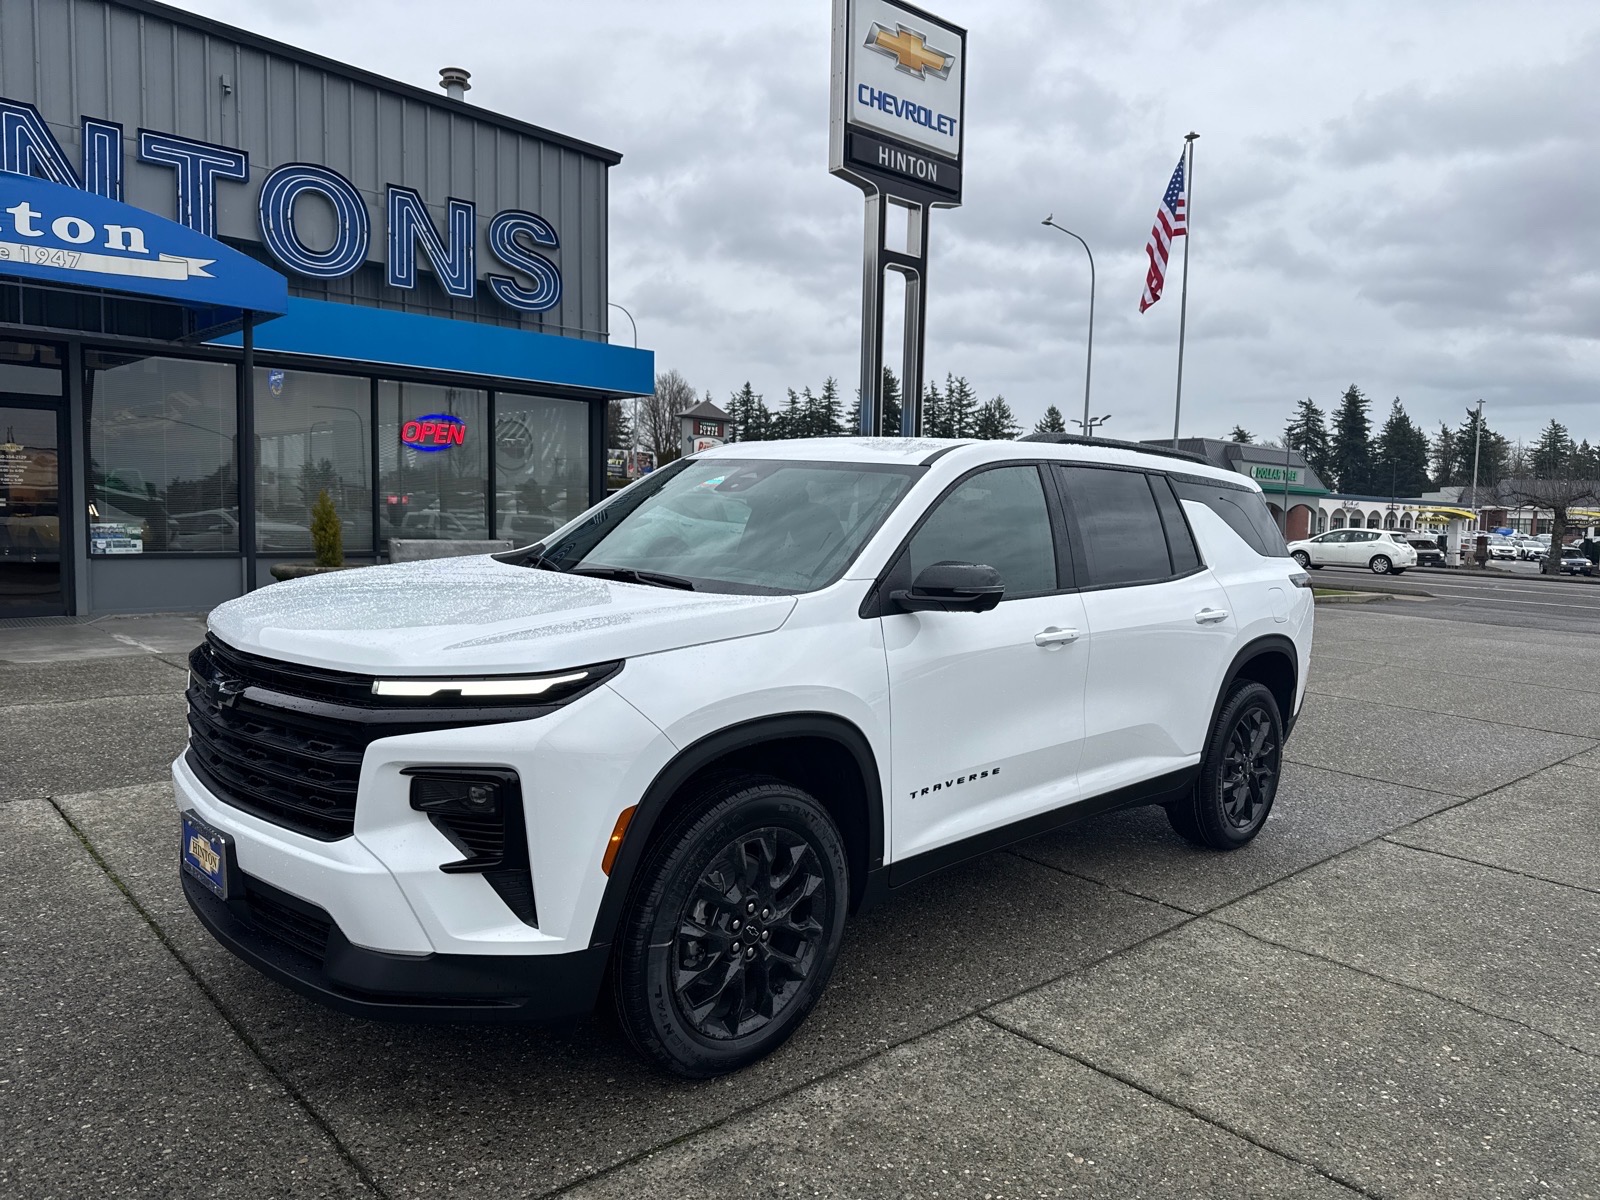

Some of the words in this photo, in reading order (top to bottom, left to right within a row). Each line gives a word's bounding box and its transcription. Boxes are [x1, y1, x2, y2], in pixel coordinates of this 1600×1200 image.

[858, 83, 957, 137] CHEVROLET
[878, 145, 938, 182] HINTON
[0, 201, 150, 258] ton
[20, 244, 82, 269] 1947
[401, 420, 466, 445] OPEN
[1256, 467, 1281, 481] DOLLAR
[909, 767, 1001, 800] TRAVERSE
[192, 840, 218, 869] HINTON
